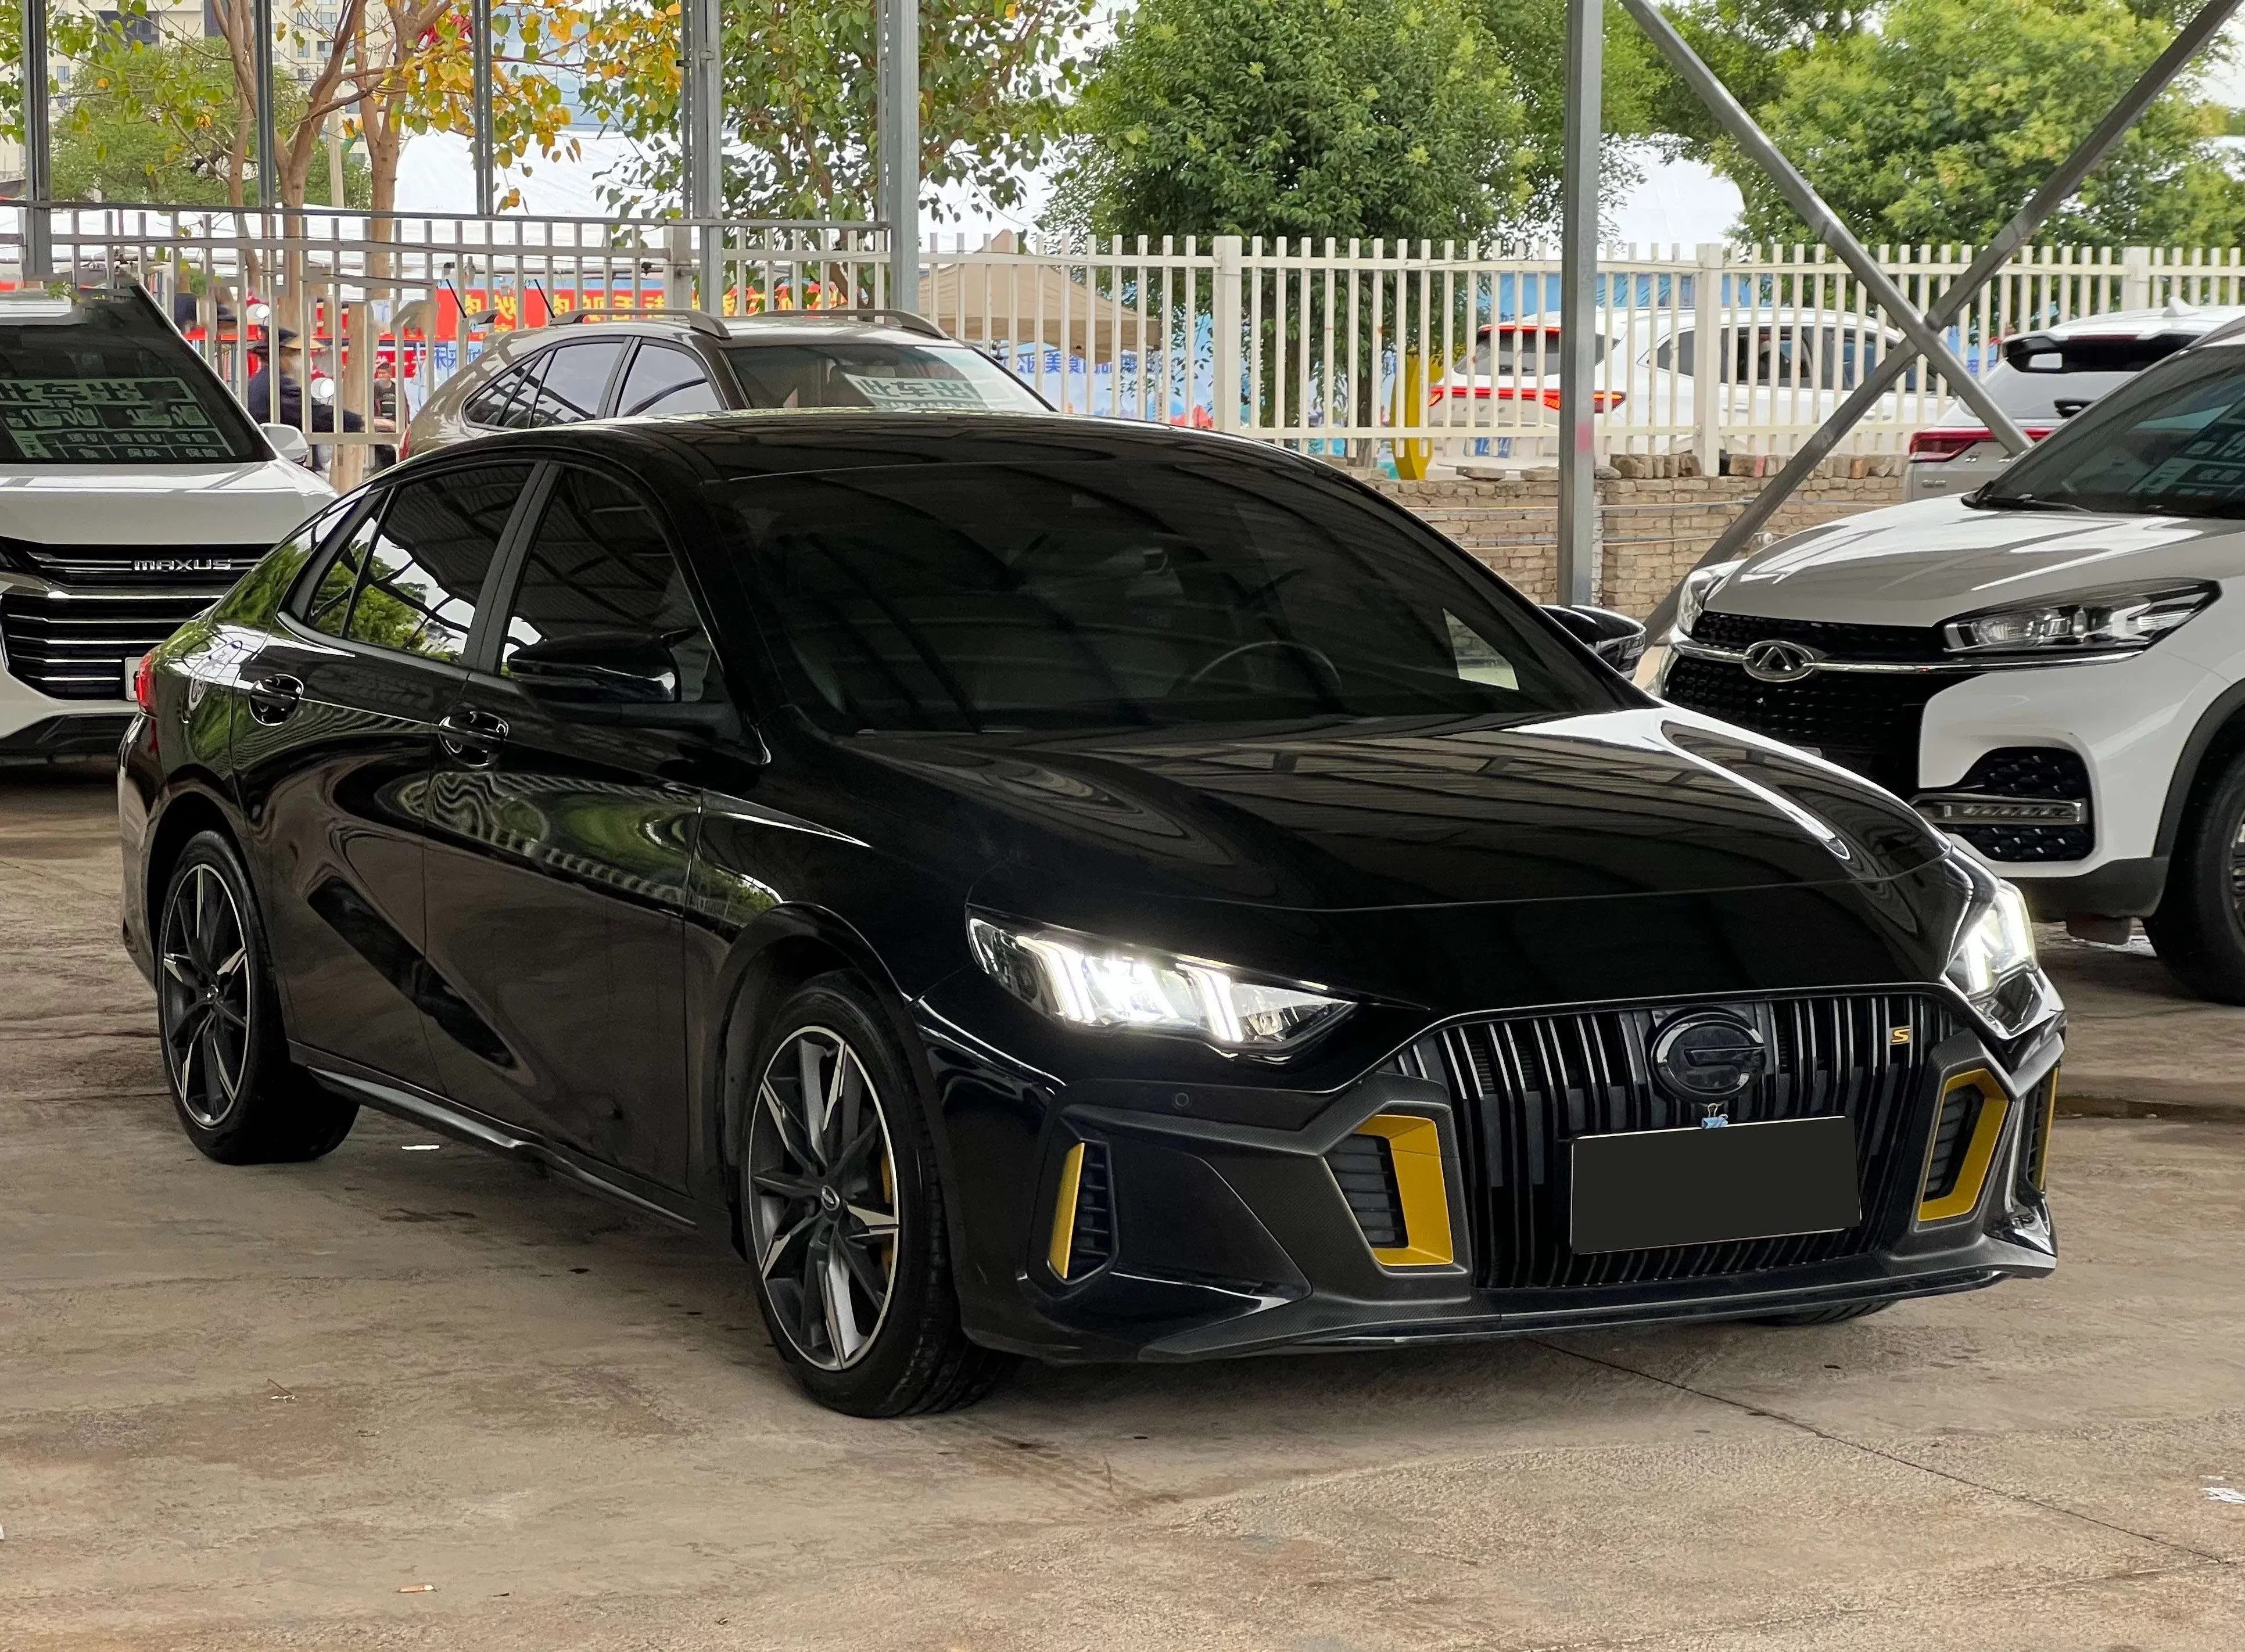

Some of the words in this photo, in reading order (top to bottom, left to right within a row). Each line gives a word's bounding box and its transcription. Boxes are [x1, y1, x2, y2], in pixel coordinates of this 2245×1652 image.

[0, 382, 188, 402] 此车出
[134, 559, 231, 571] MAXUS
[1891, 1028, 1910, 1043] S
